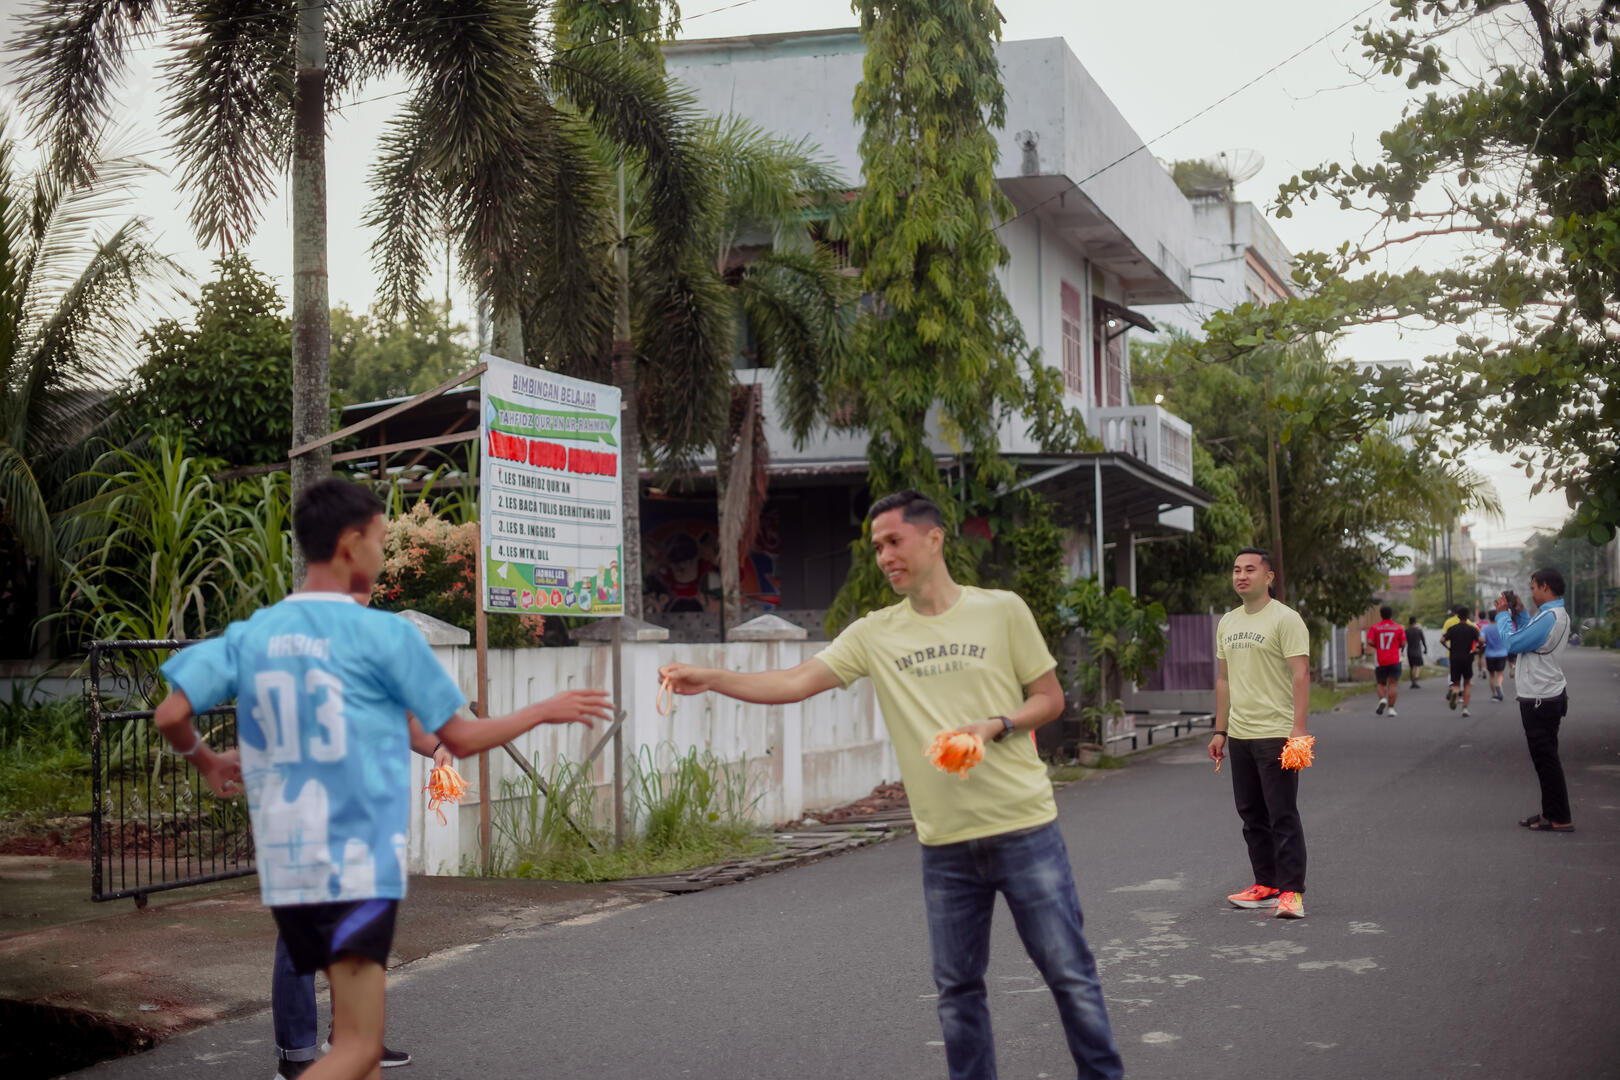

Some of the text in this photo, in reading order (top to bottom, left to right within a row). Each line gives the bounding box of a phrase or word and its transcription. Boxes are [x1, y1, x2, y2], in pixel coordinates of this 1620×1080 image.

[512, 374, 596, 408] BIMBINGAN BELAJAR
[499, 410, 534, 428] TAHFIDZ
[504, 472, 516, 485] LES
[518, 474, 545, 491] TAHFIDZ
[505, 496, 517, 510] LES
[518, 499, 538, 513] BACA
[538, 502, 557, 516] TULIS
[506, 521, 518, 534] LES
[528, 524, 556, 538] INGGRIS
[506, 546, 518, 558] LES
[538, 550, 549, 561] DLL
[1224, 631, 1265, 645] INDRAGIRI
[1379, 631, 1395, 650] 17
[895, 642, 987, 671] INDRAGIRI
[250, 668, 348, 763] 03
